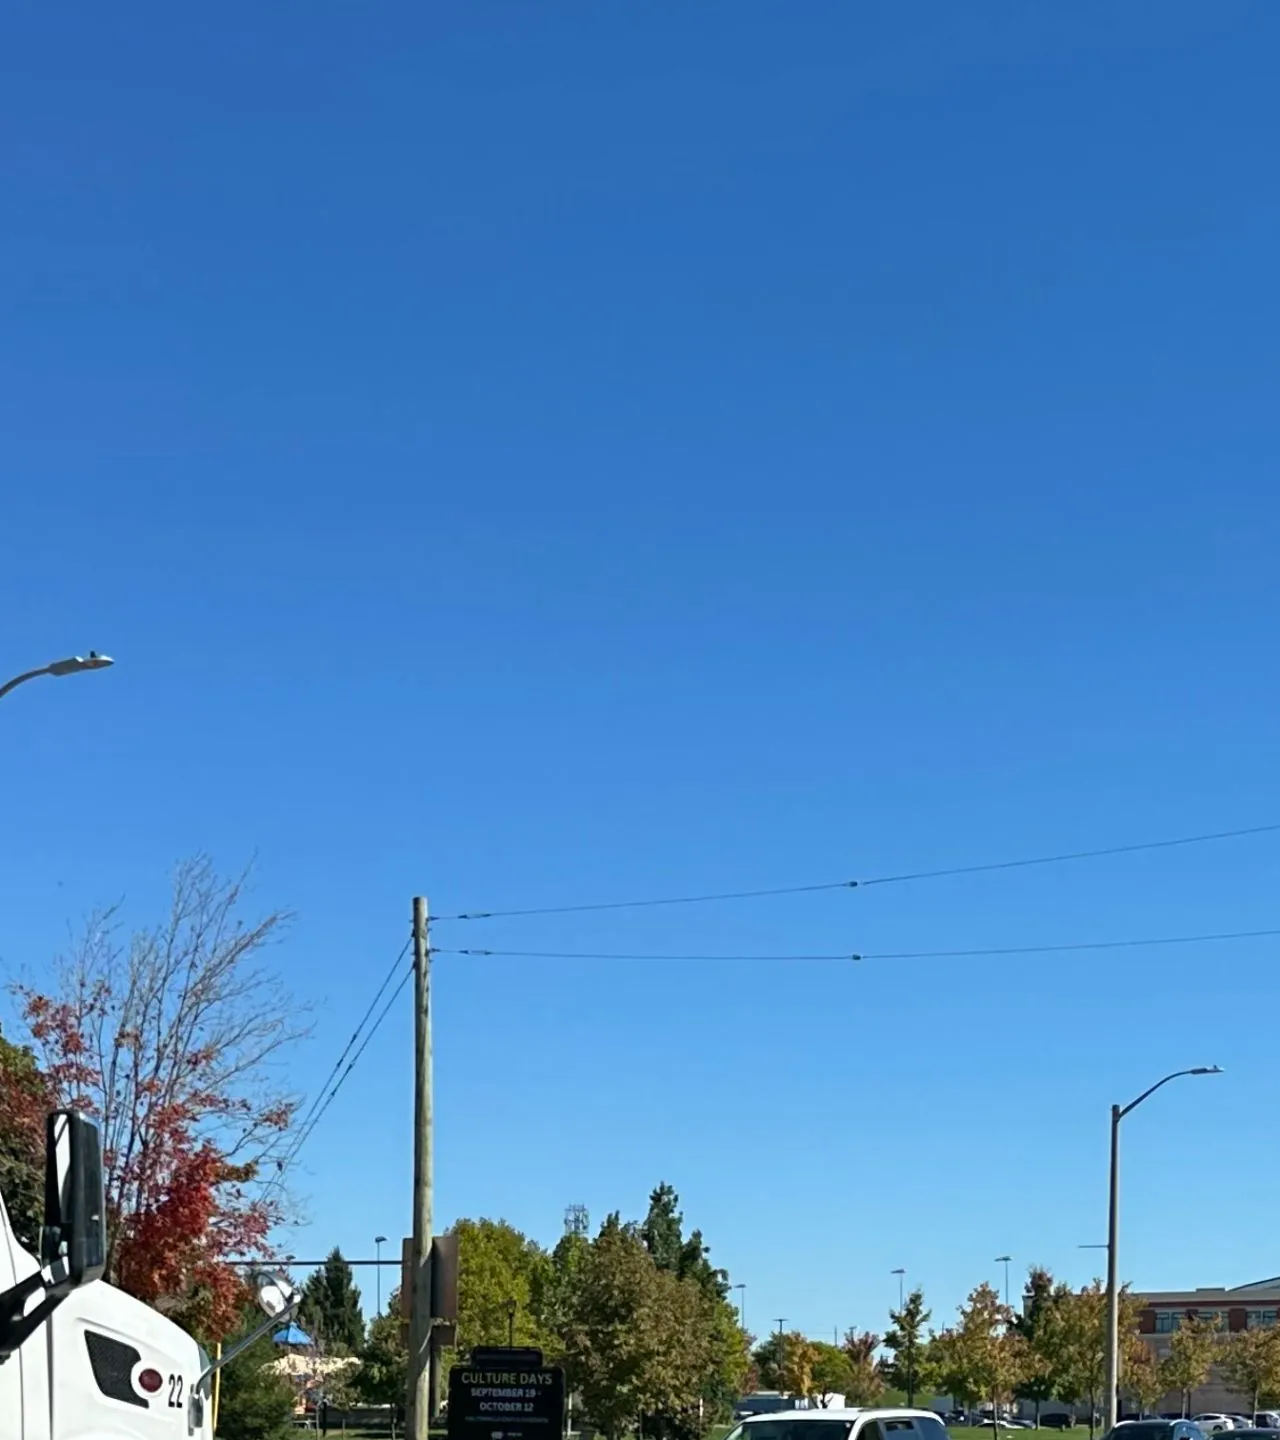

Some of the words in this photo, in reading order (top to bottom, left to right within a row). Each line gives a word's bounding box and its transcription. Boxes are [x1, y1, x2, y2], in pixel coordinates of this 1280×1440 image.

[461, 1372, 517, 1384] CULTURE
[520, 1372, 553, 1385] DAYS
[168, 1373, 183, 1409] 22
[471, 1387, 524, 1397] SEPTEMBER
[479, 1402, 522, 1411] OCTOBER
[523, 1402, 534, 1412] 12
